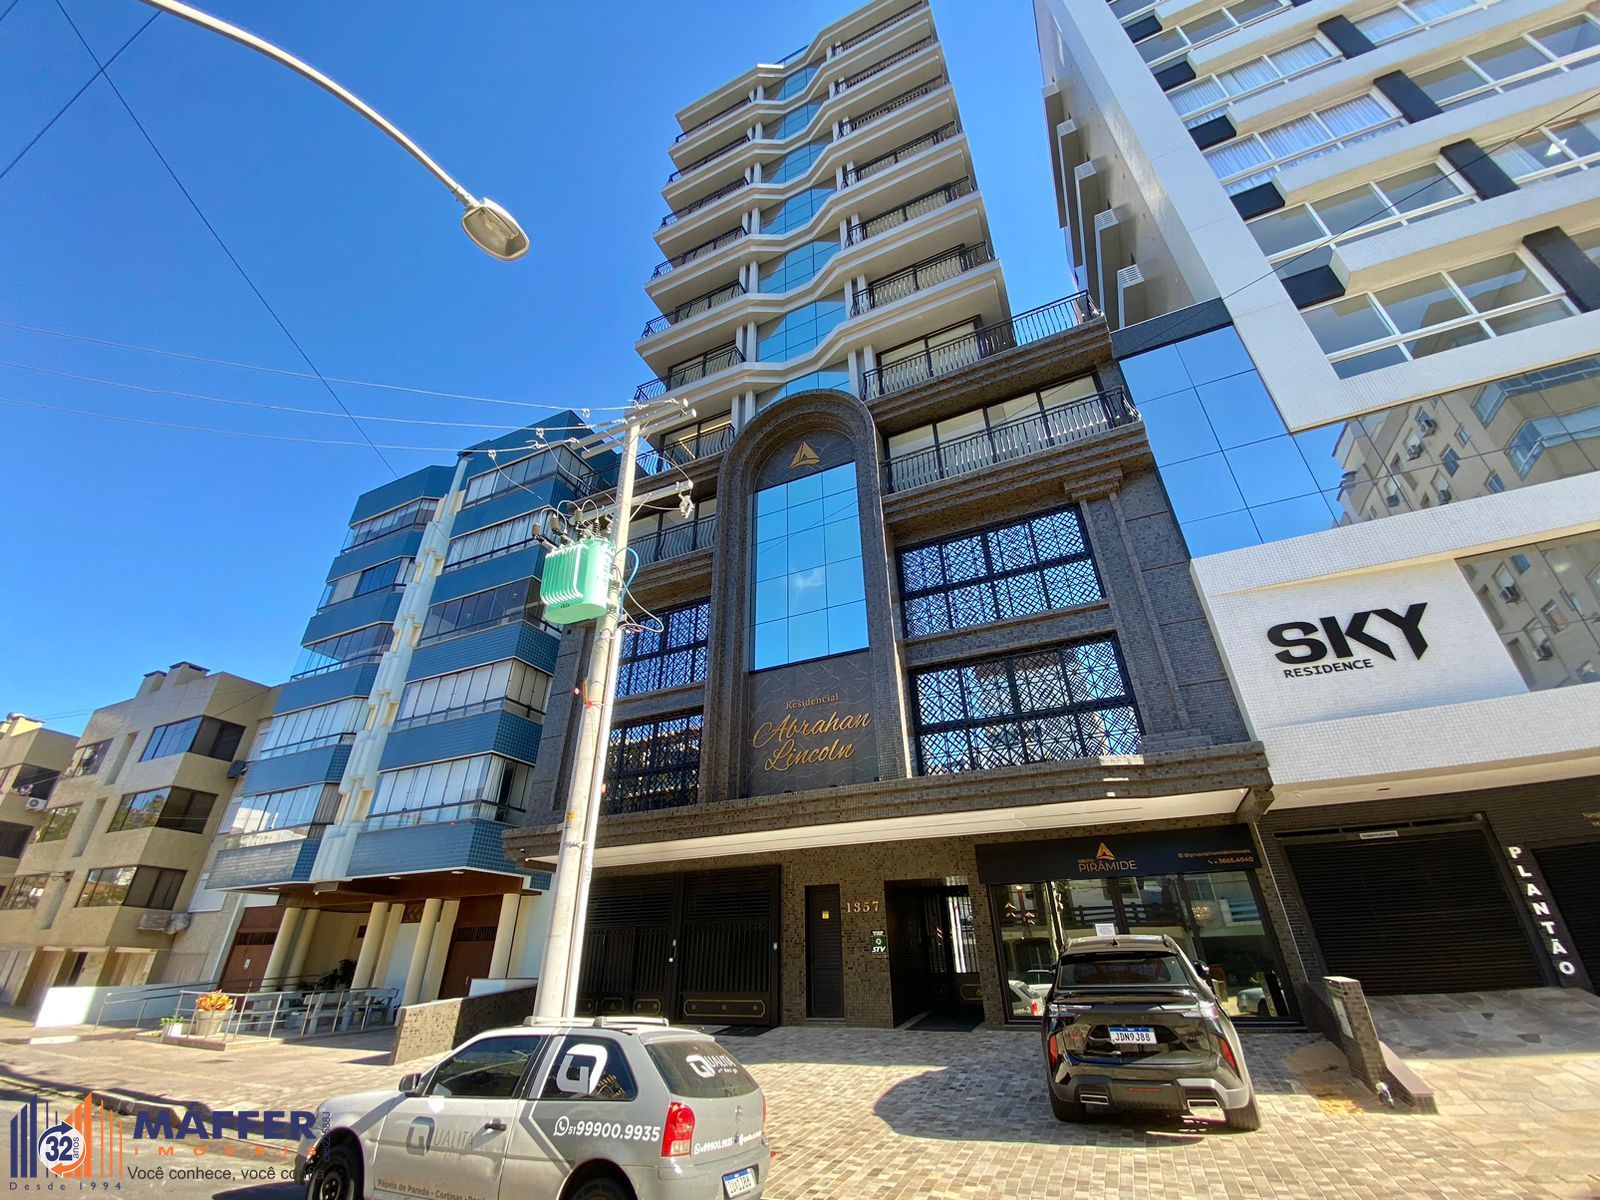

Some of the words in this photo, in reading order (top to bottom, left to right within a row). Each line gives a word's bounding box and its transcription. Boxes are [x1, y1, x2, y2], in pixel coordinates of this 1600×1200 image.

[1266, 602, 1428, 665] SKY
[1283, 659, 1374, 678] RESIDENCE
[785, 693, 840, 710] Residencial
[752, 711, 872, 748] Abrahan
[764, 738, 855, 772] Lincoln
[846, 901, 880, 913] 1357
[1508, 846, 1576, 975] PLANTÃO
